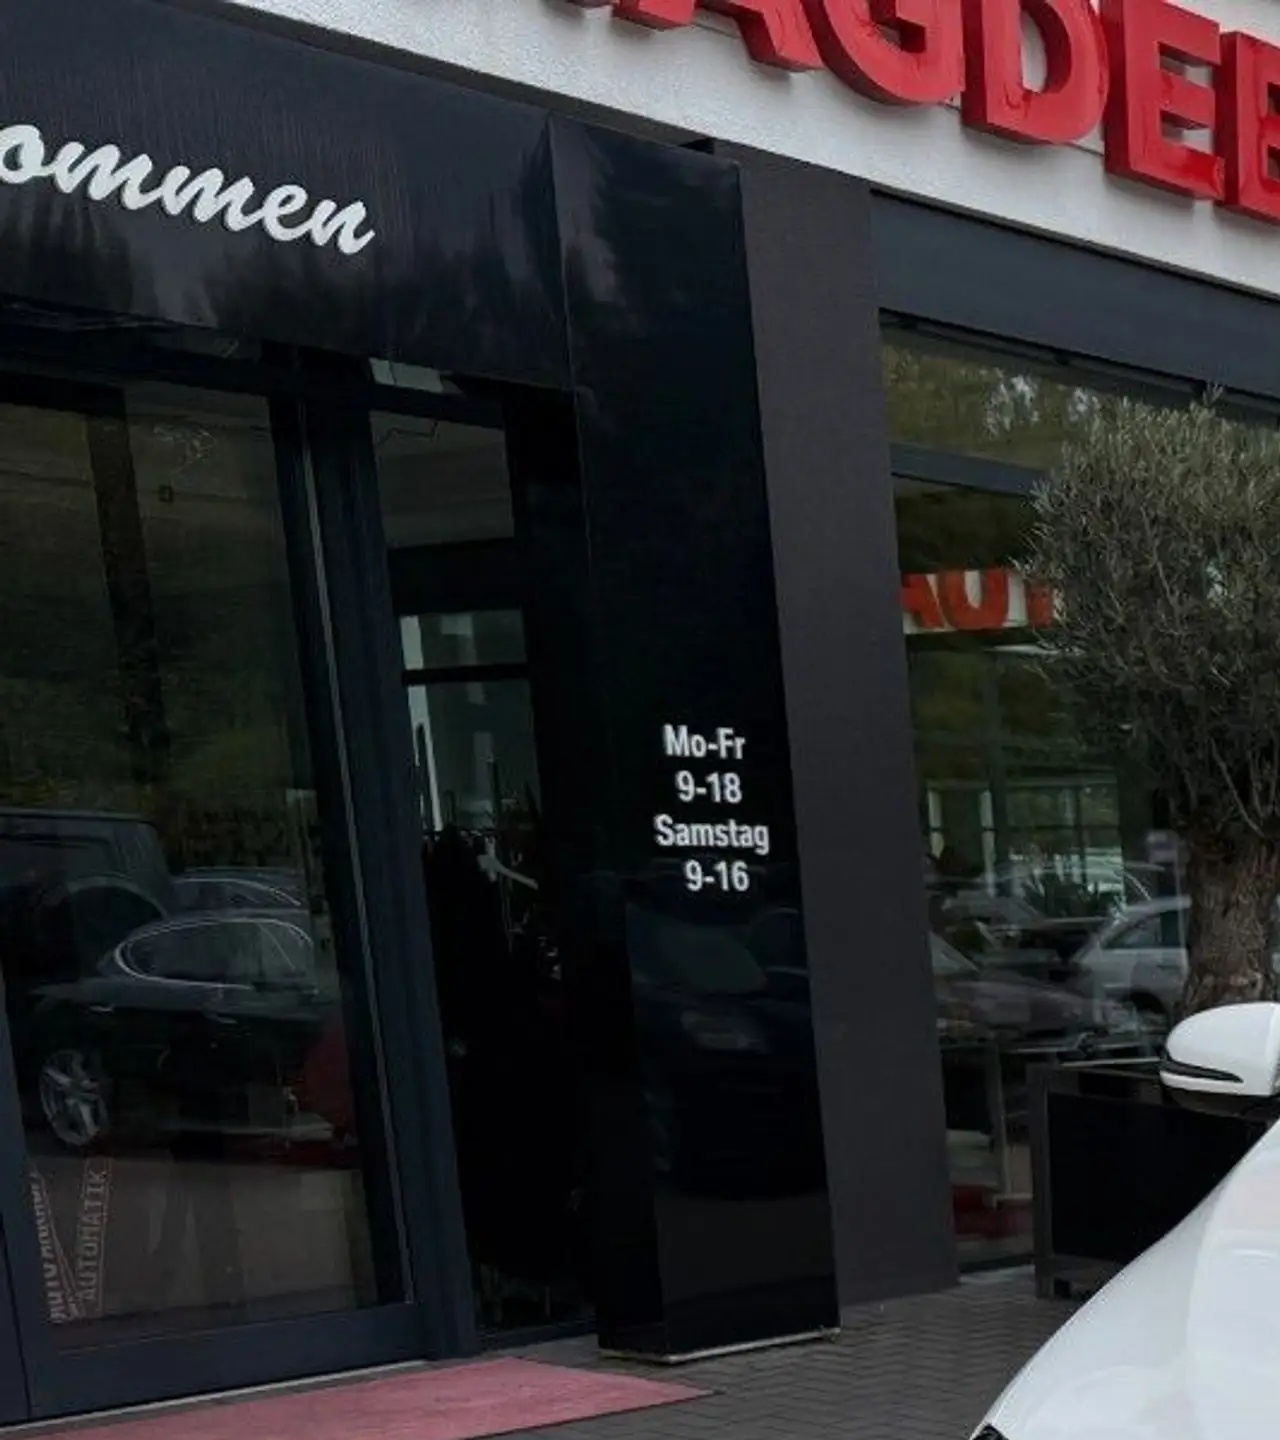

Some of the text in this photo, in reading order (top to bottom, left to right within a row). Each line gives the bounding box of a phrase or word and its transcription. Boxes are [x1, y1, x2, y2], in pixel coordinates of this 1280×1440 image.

[662, 723, 747, 760] Mo-Fr
[674, 769, 744, 804] 9-18
[653, 813, 770, 856] Samstag
[684, 859, 751, 893] 9-16
